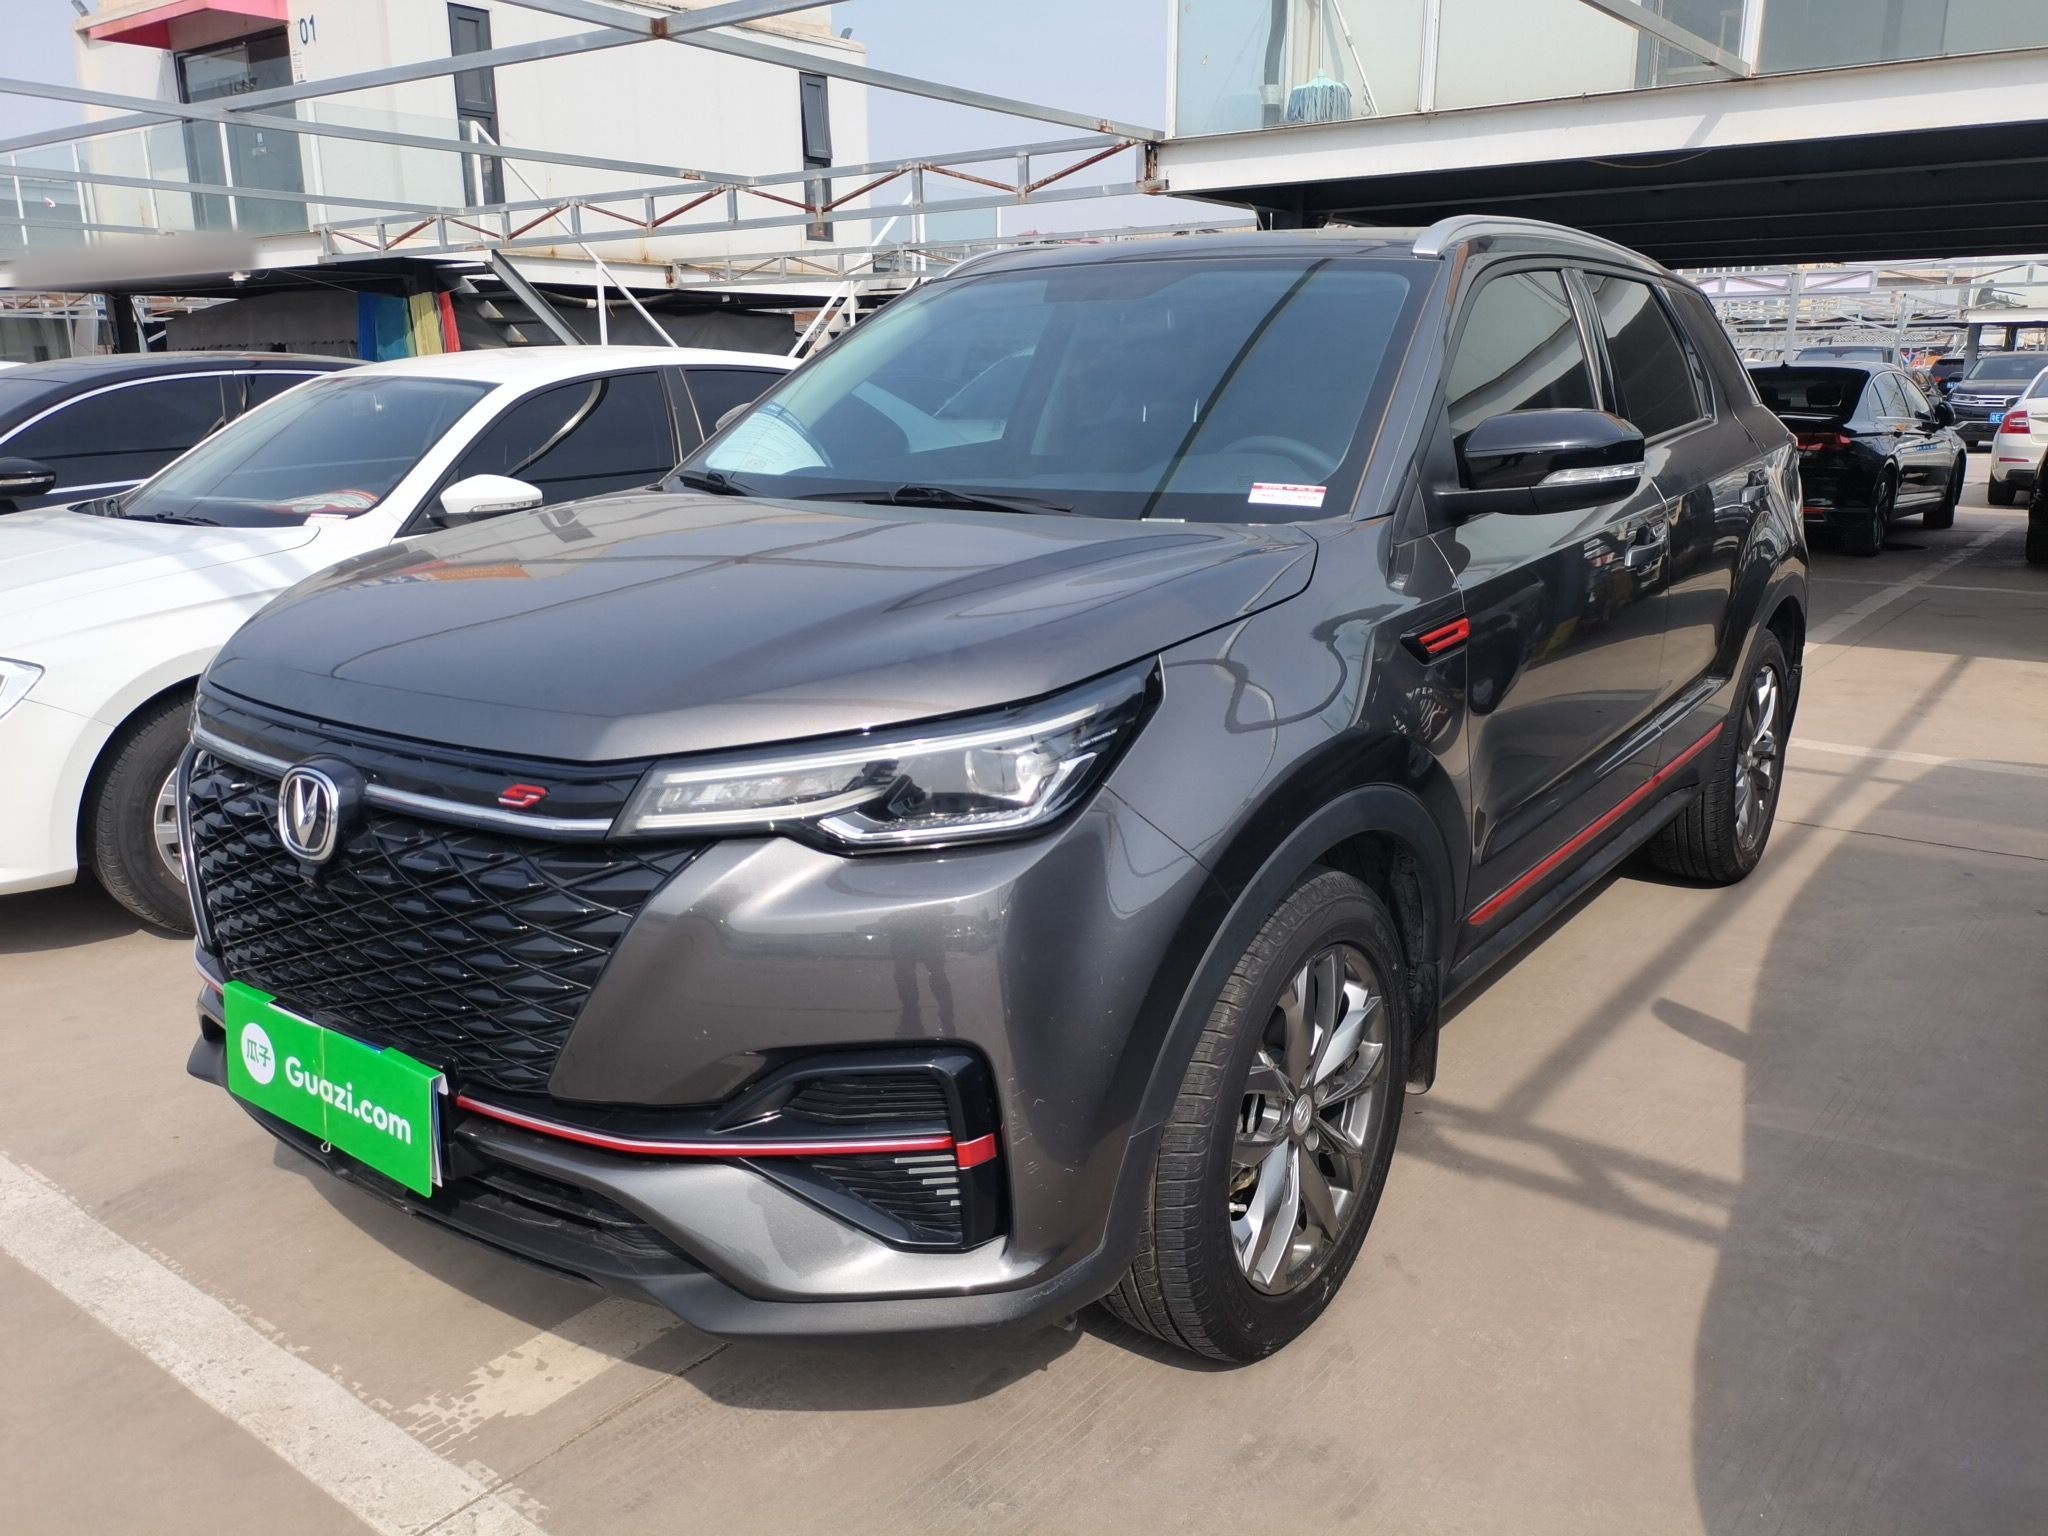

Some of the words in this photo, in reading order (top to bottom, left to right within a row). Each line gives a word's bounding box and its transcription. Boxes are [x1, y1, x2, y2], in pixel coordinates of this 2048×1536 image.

[299, 14, 317, 46] 01
[245, 1037, 272, 1068] 瓜子
[285, 1056, 412, 1145] Guazi.com
